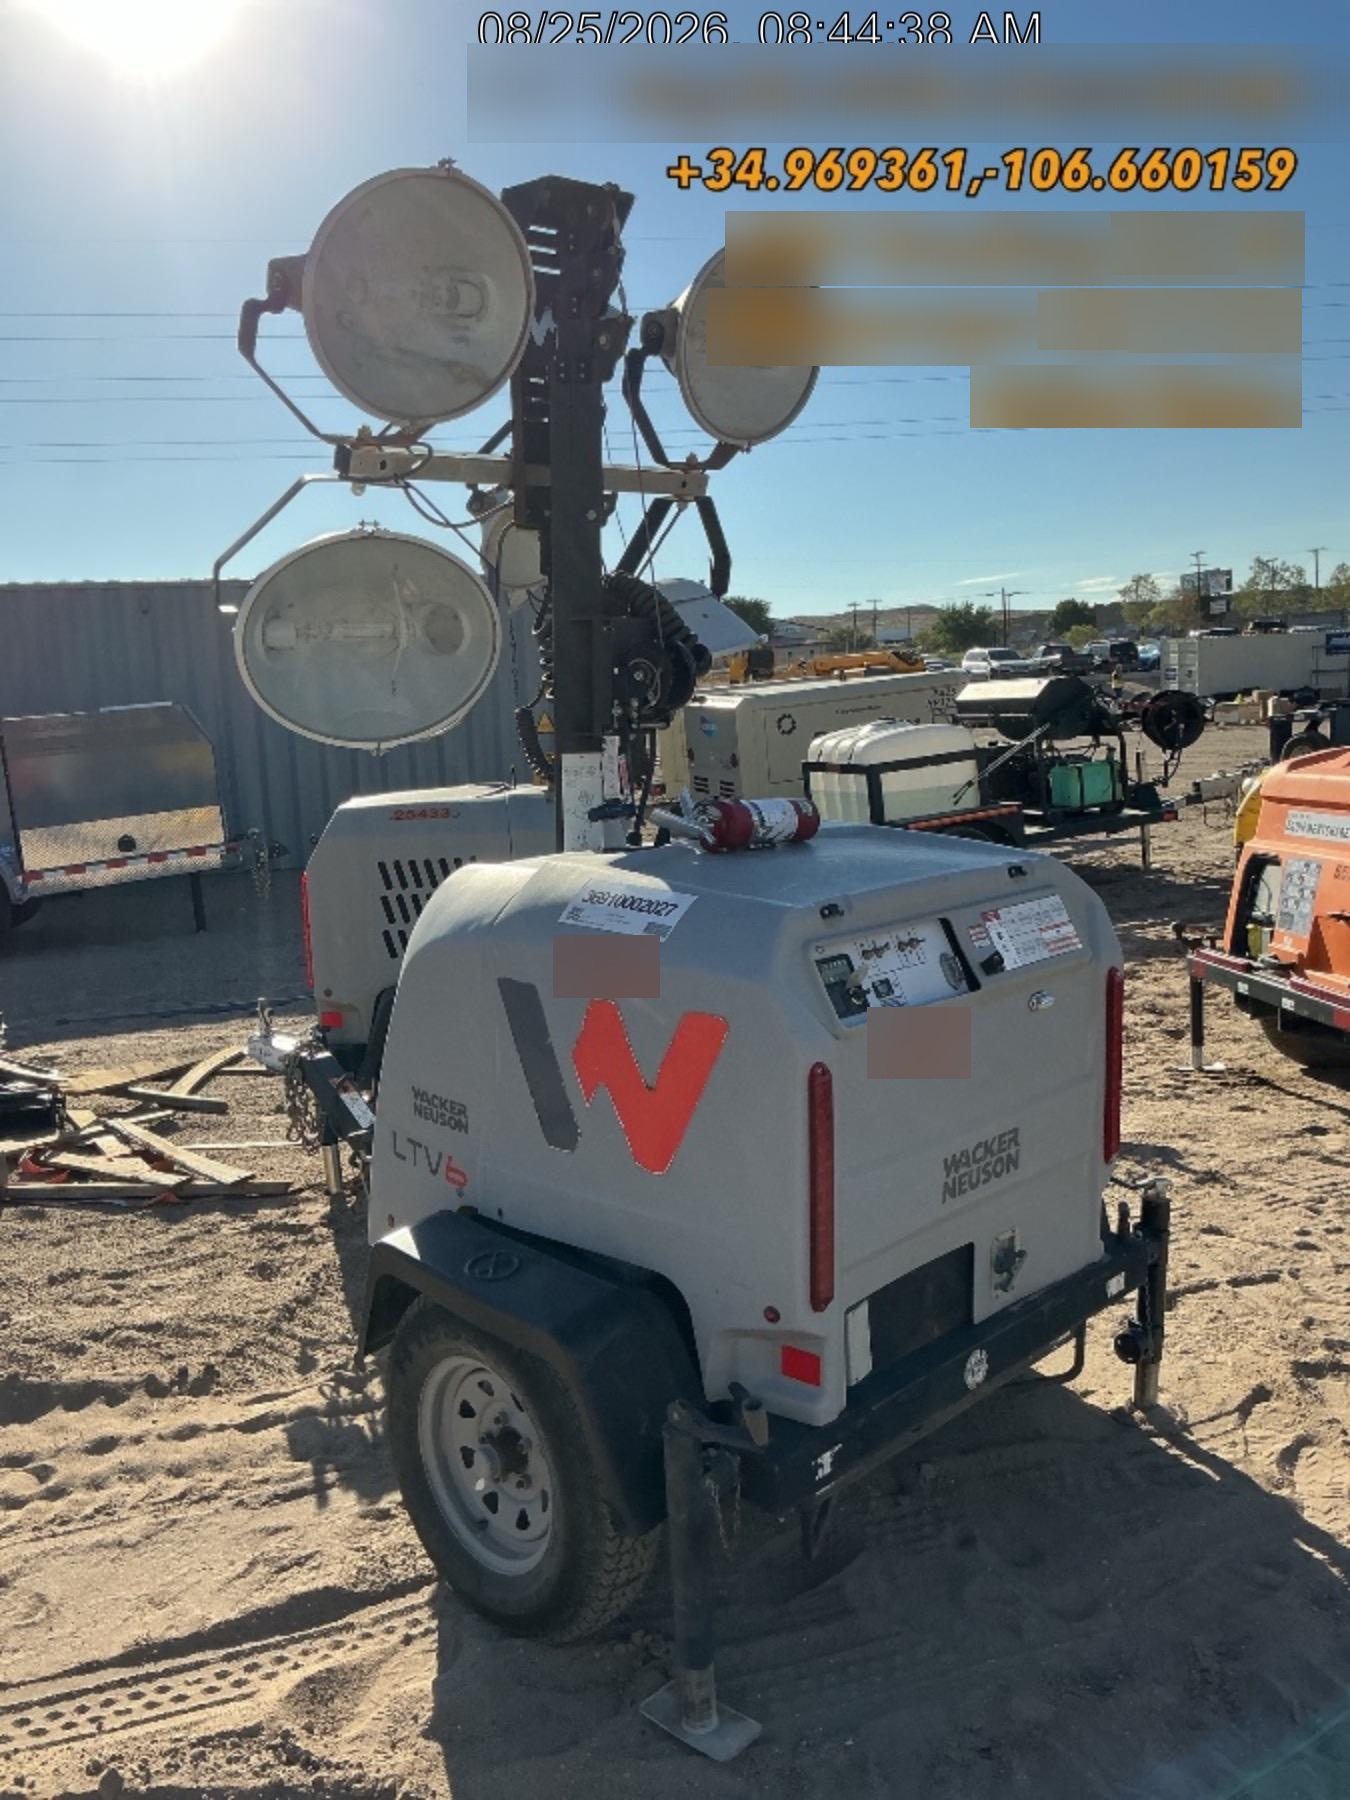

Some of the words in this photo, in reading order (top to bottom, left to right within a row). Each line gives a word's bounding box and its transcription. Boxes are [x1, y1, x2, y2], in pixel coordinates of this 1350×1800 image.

[411, 1085, 468, 1120] WACKER
[413, 1102, 469, 1135] NEUSON
[392, 1130, 468, 1187] LTV6
[942, 1149, 1020, 1204] NEUSON
[943, 1127, 1020, 1179] WACKER
